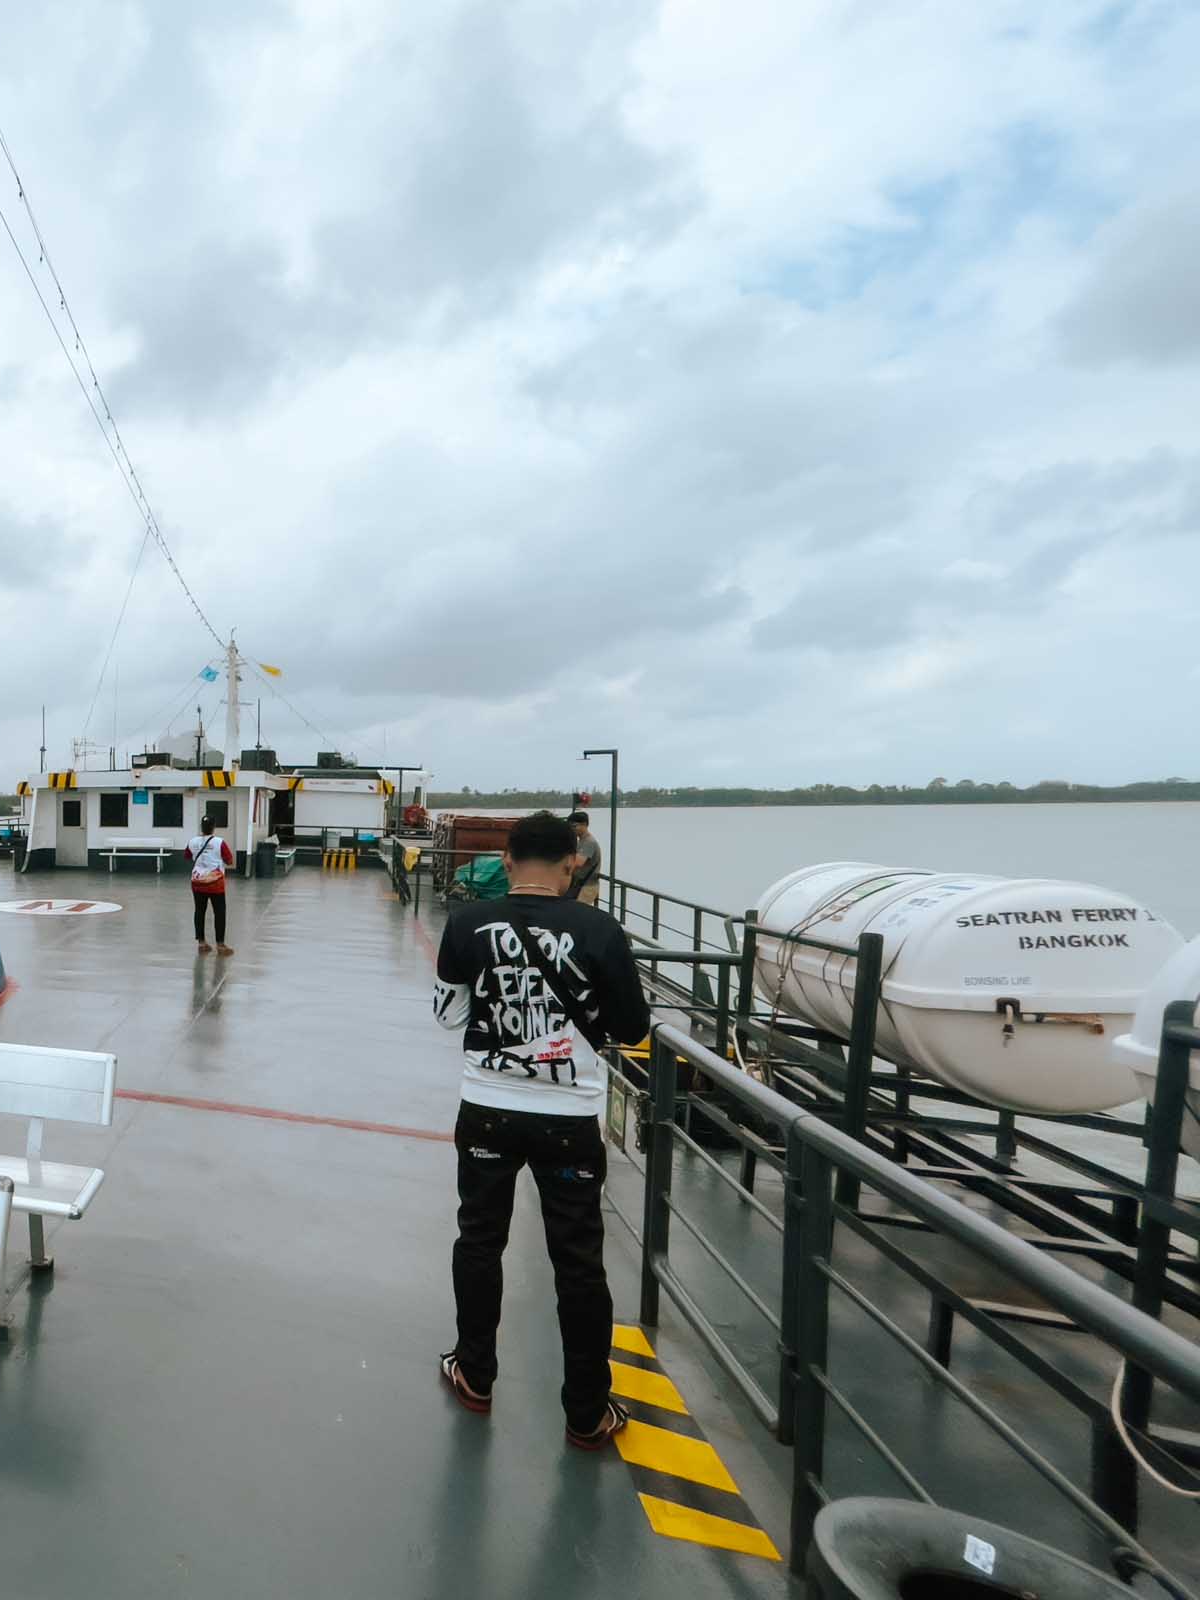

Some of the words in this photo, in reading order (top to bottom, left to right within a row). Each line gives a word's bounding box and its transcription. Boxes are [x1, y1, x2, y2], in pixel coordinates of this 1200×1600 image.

[956, 909, 1063, 928] SEATRAN
[1071, 908, 1137, 922] FERRY
[1018, 933, 1130, 950] BANGKOK
[1010, 976, 1033, 985] LINE
